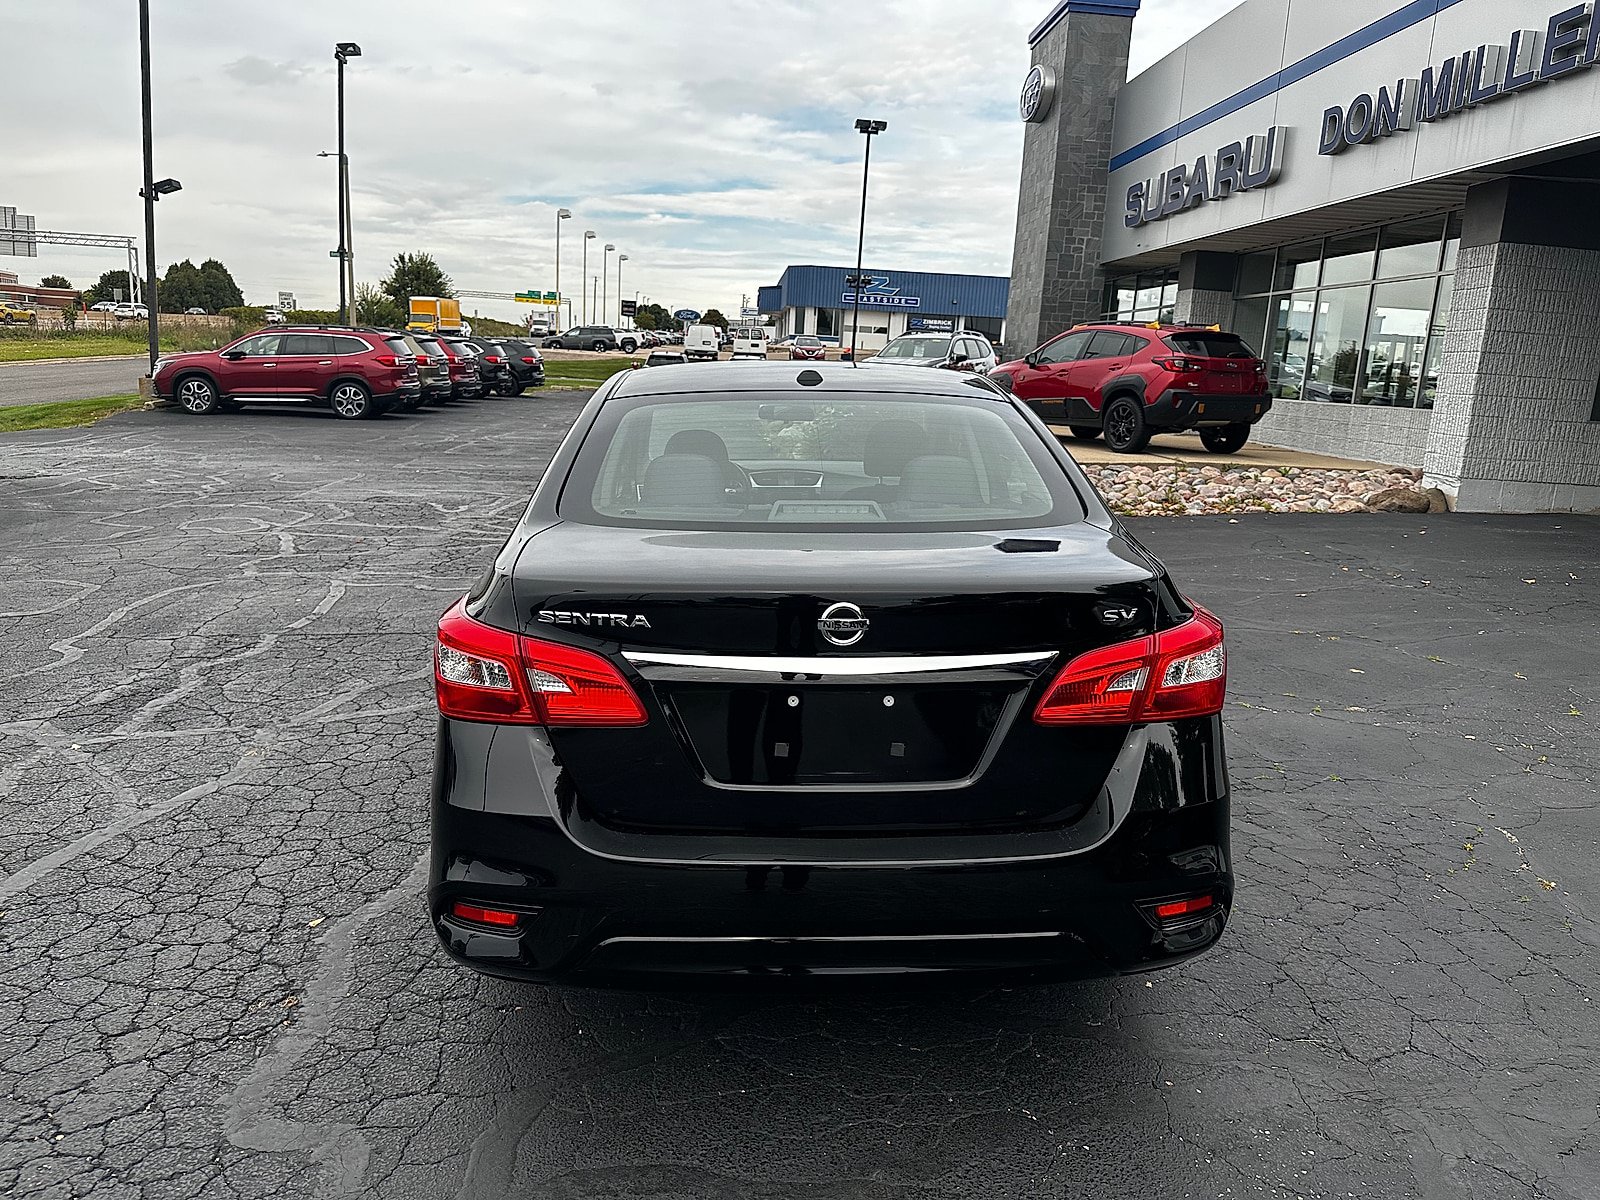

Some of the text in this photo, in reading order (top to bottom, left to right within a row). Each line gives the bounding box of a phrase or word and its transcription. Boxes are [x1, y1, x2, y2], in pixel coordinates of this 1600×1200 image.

[1318, 77, 1406, 155] DON
[1123, 125, 1279, 228] SUBARU
[280, 301, 292, 309] 55
[856, 295, 907, 305] ASTSIDE
[678, 310, 697, 320] Ford
[538, 610, 651, 628] SENTRA
[1102, 608, 1138, 622] SV
[822, 619, 866, 631] NISSAN
